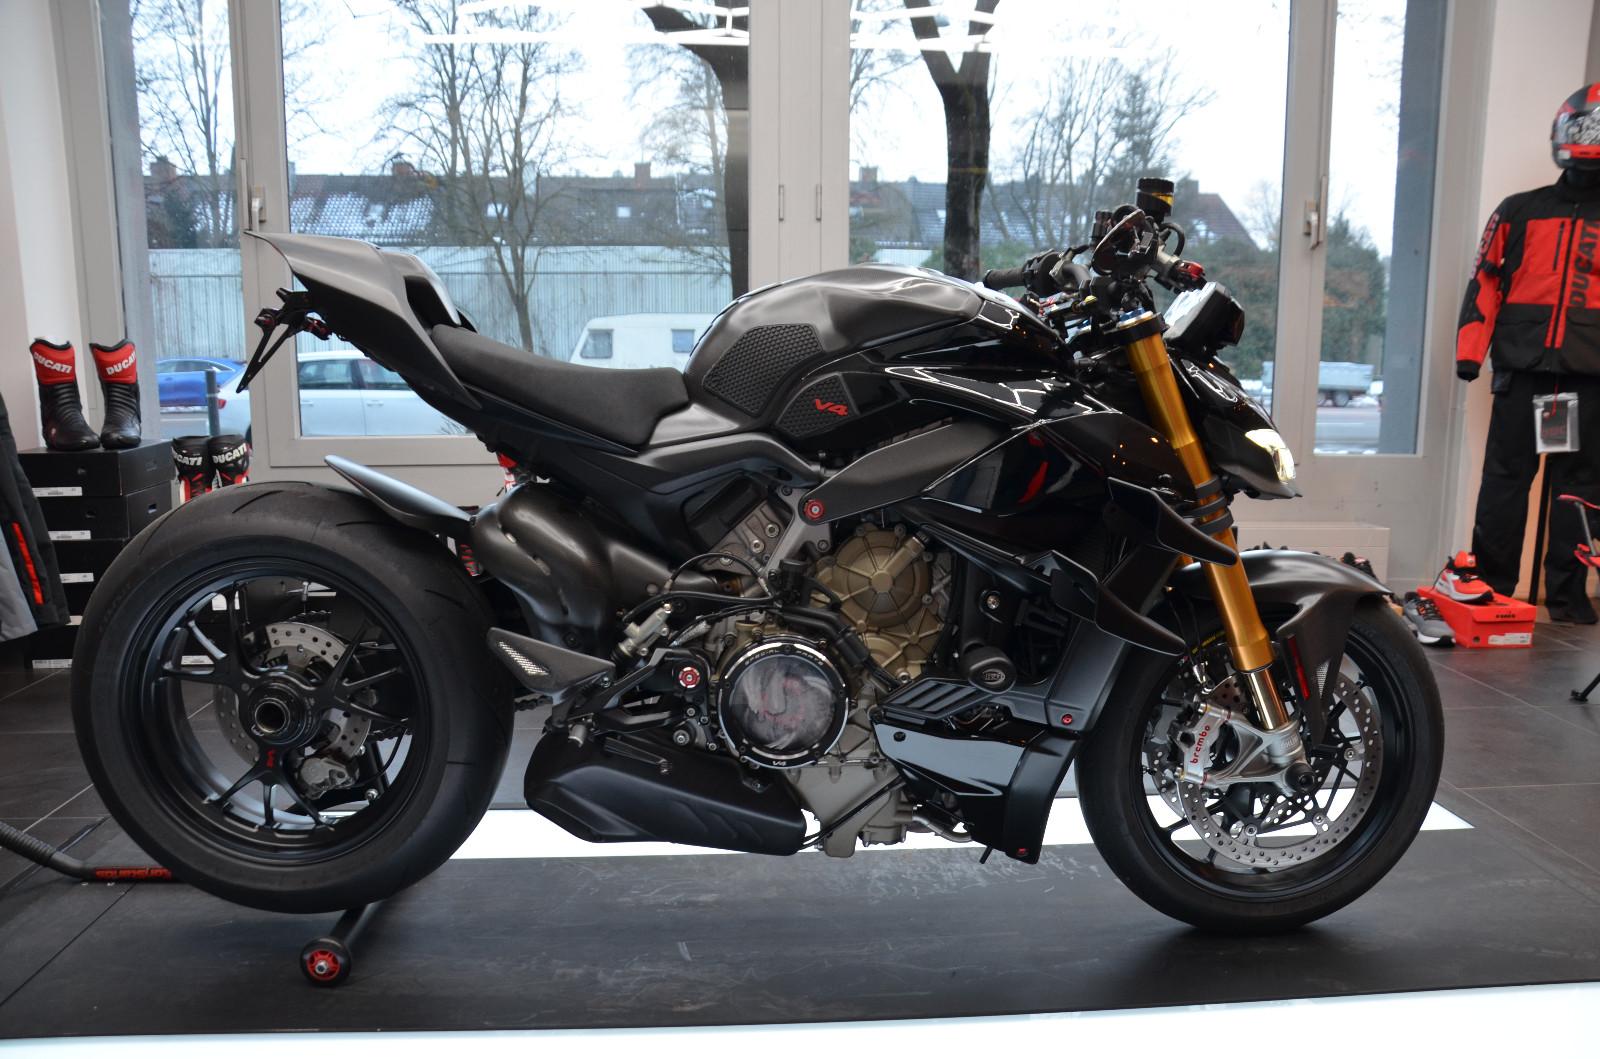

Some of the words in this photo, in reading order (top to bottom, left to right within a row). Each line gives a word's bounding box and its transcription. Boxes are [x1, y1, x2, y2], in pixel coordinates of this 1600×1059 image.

[33, 352, 72, 374] DUCATI
[815, 398, 848, 417] V4
[212, 443, 248, 464] DUCATI
[1189, 724, 1211, 765] brembo
